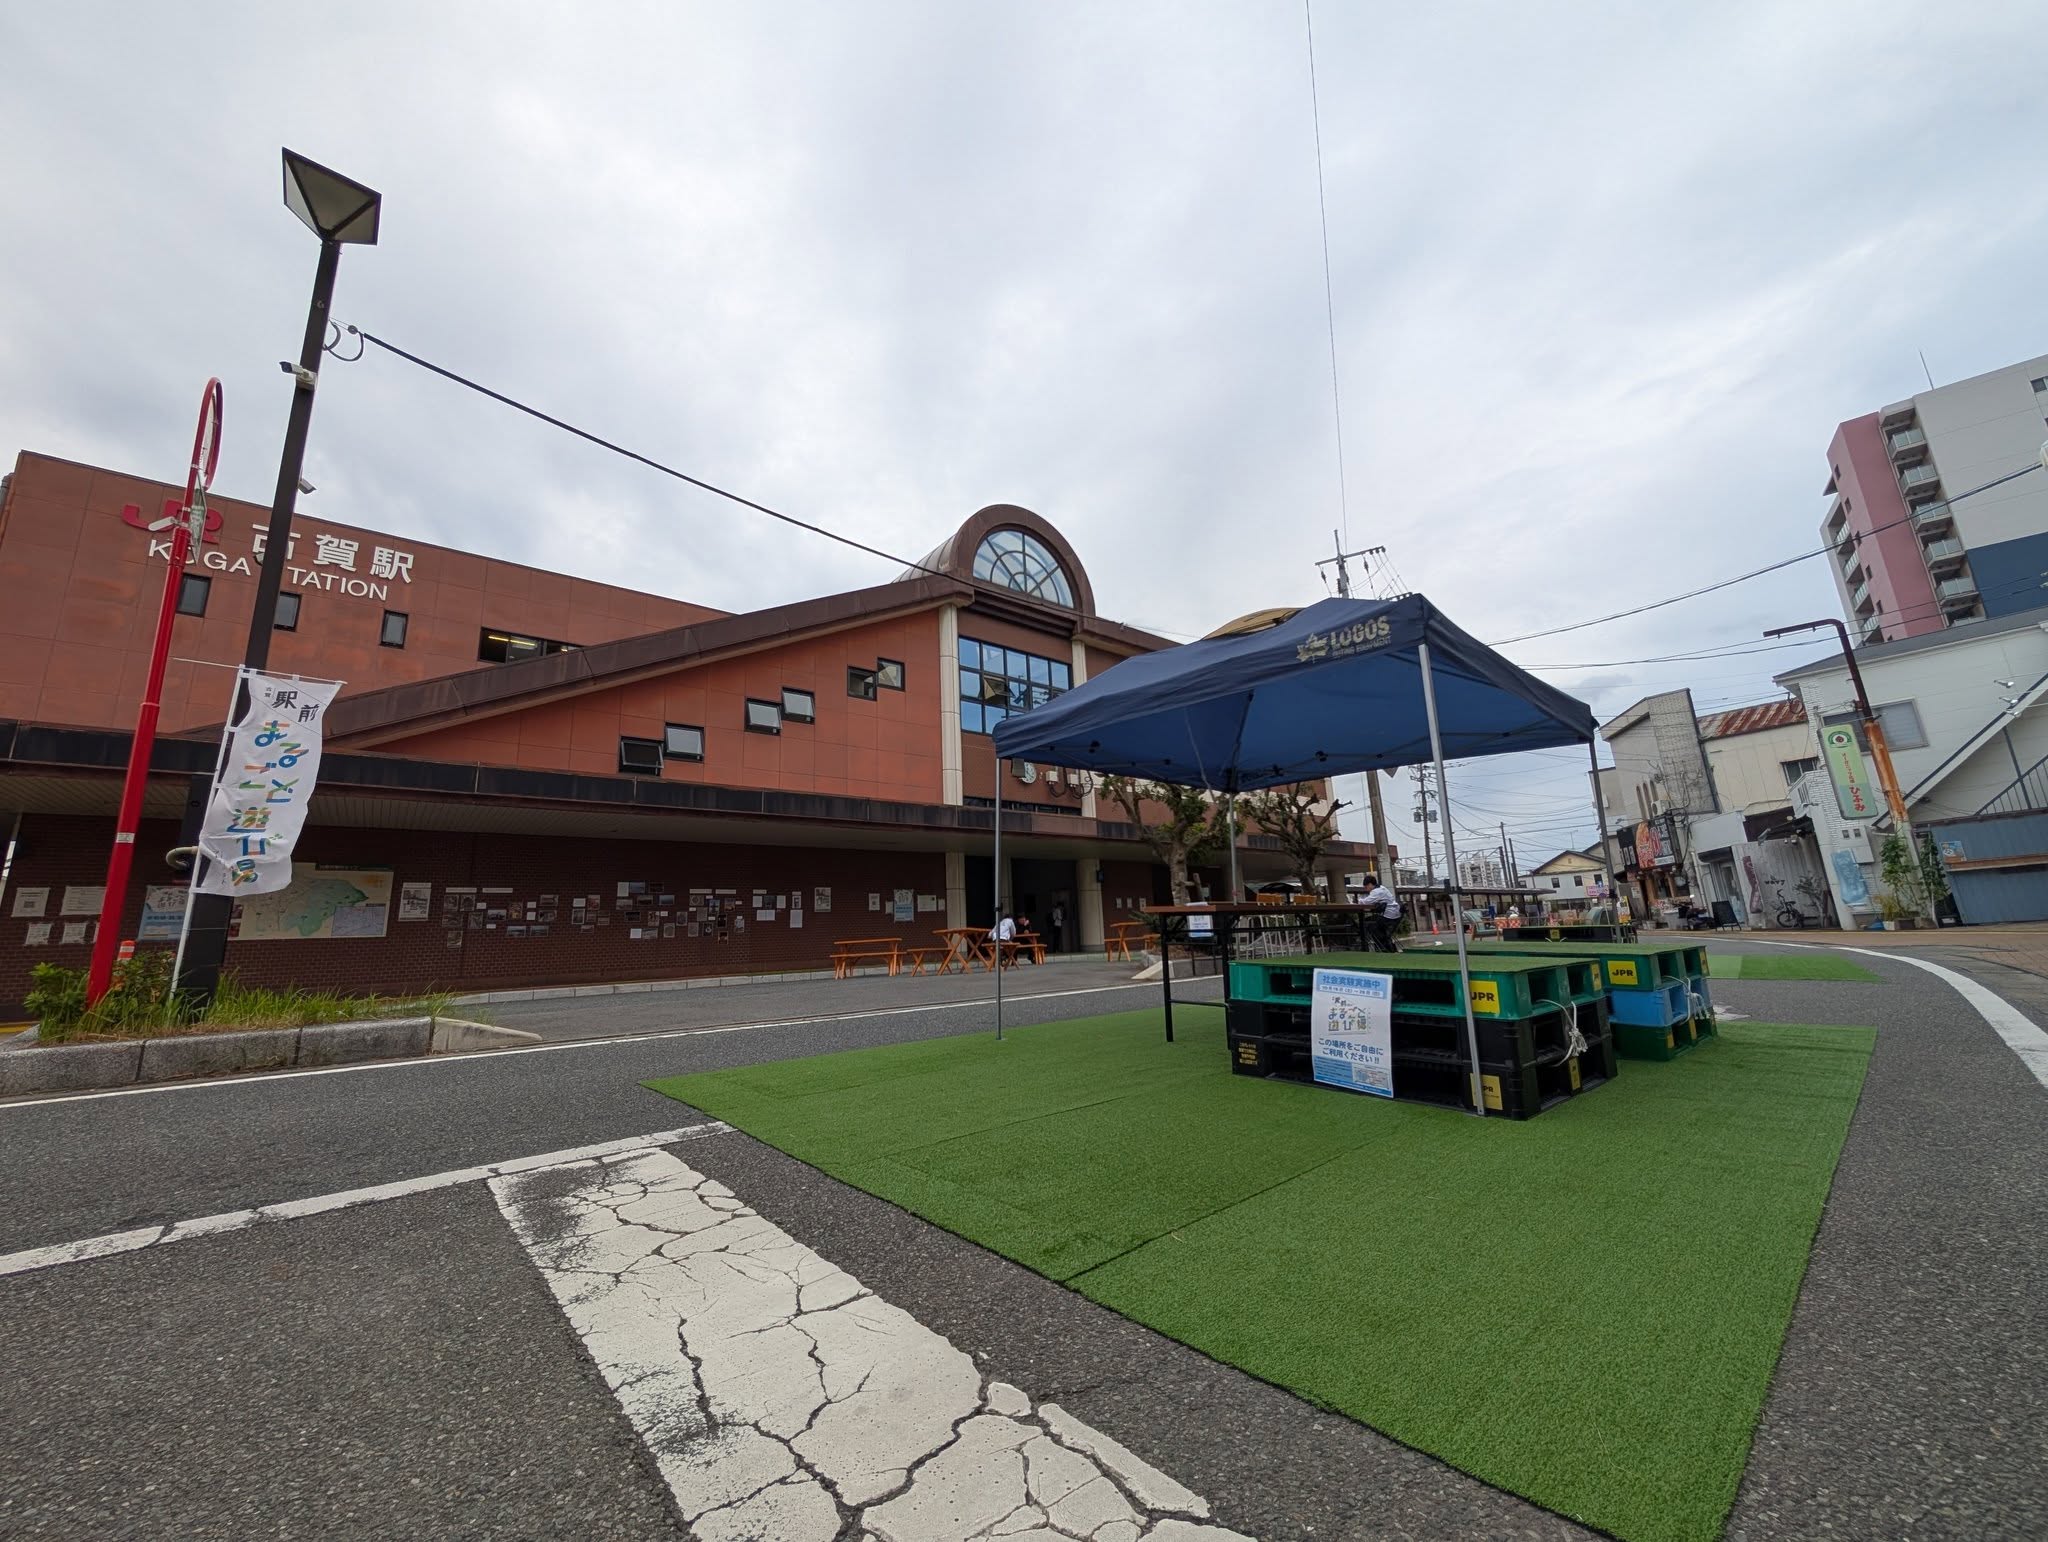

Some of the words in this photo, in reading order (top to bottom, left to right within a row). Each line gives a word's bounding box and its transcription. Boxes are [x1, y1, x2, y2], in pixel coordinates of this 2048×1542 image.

[149, 539, 252, 576] KGA
[287, 566, 388, 601] TATION
[1330, 616, 1390, 649] LOGOS
[271, 690, 320, 723] 駅前
[1849, 787, 1866, 812] ひふみ
[1322, 975, 1381, 990] 社会実験実施中
[1612, 968, 1634, 977] JPR
[1318, 1037, 1384, 1056] この場所をご自由に
